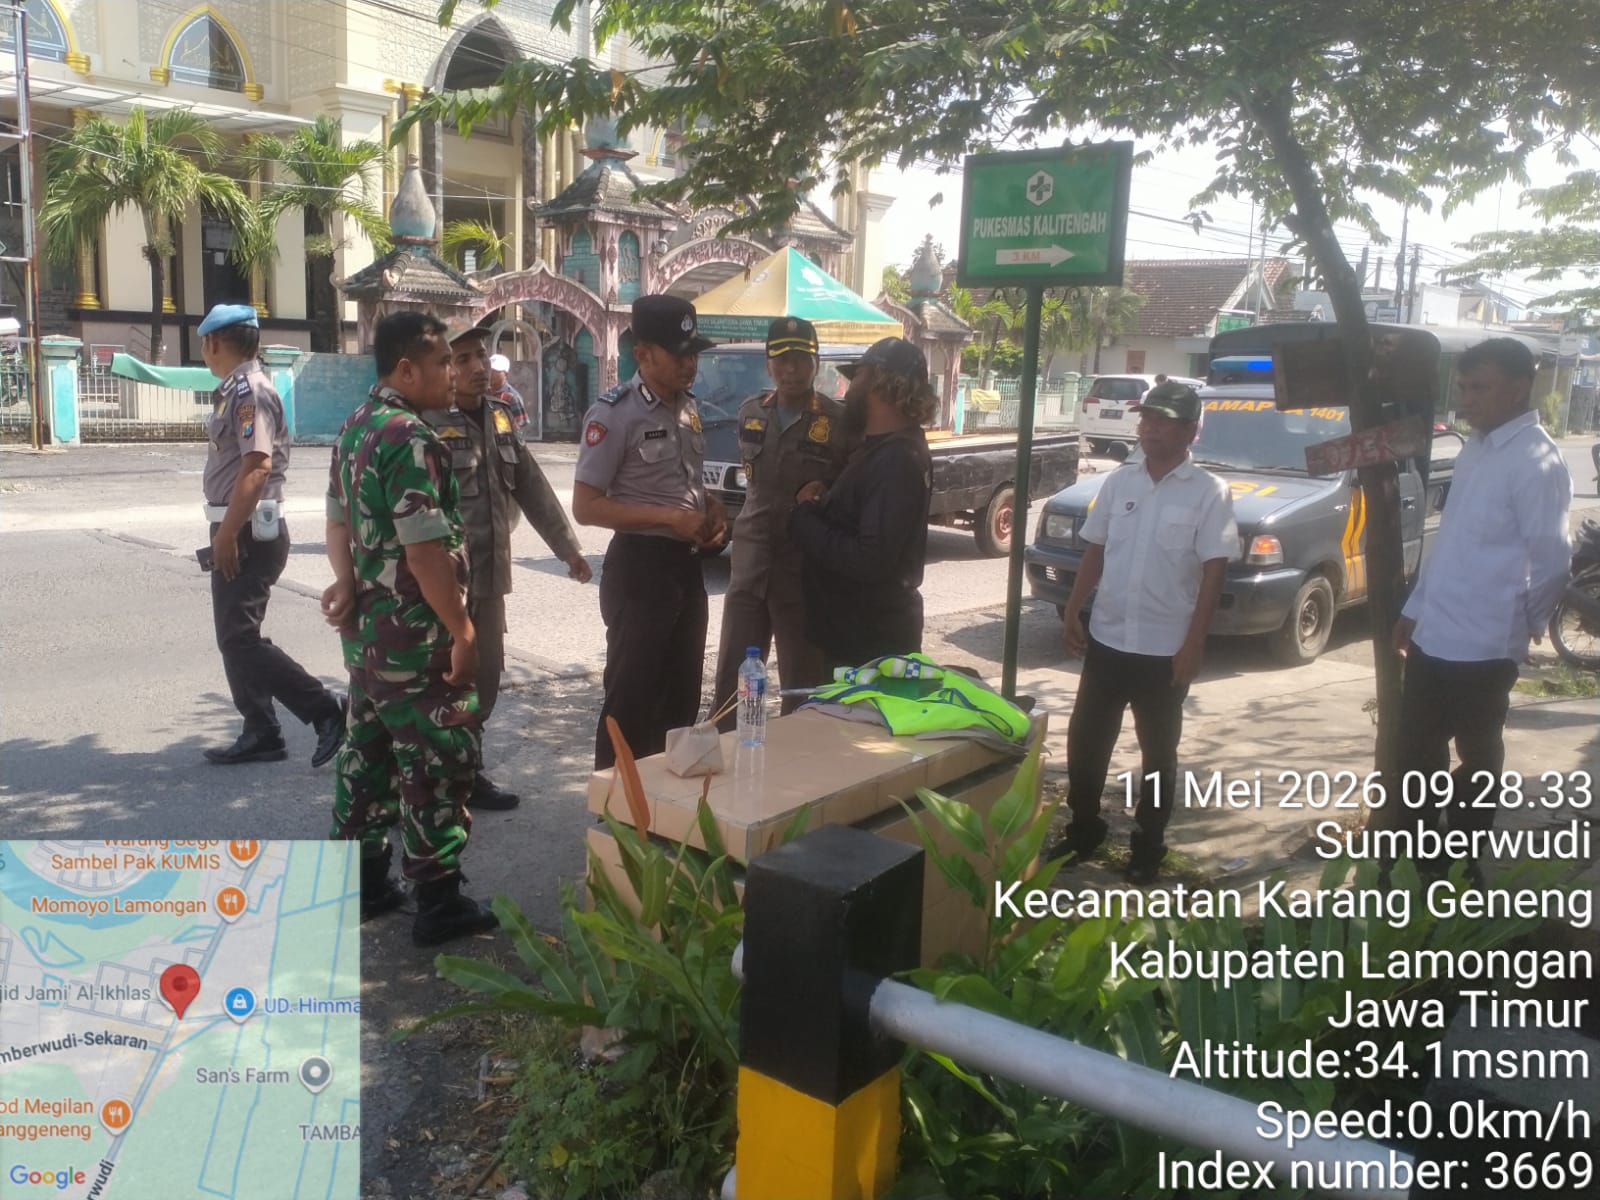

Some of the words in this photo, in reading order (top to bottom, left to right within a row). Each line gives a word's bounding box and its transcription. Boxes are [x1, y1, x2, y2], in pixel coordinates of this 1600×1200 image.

[973, 216, 1031, 239] PUKESMAS
[1033, 212, 1108, 236] KALITENGAH
[1023, 251, 1041, 262] KM
[1203, 400, 1305, 415] AMAP
[1309, 407, 1345, 422] 1401
